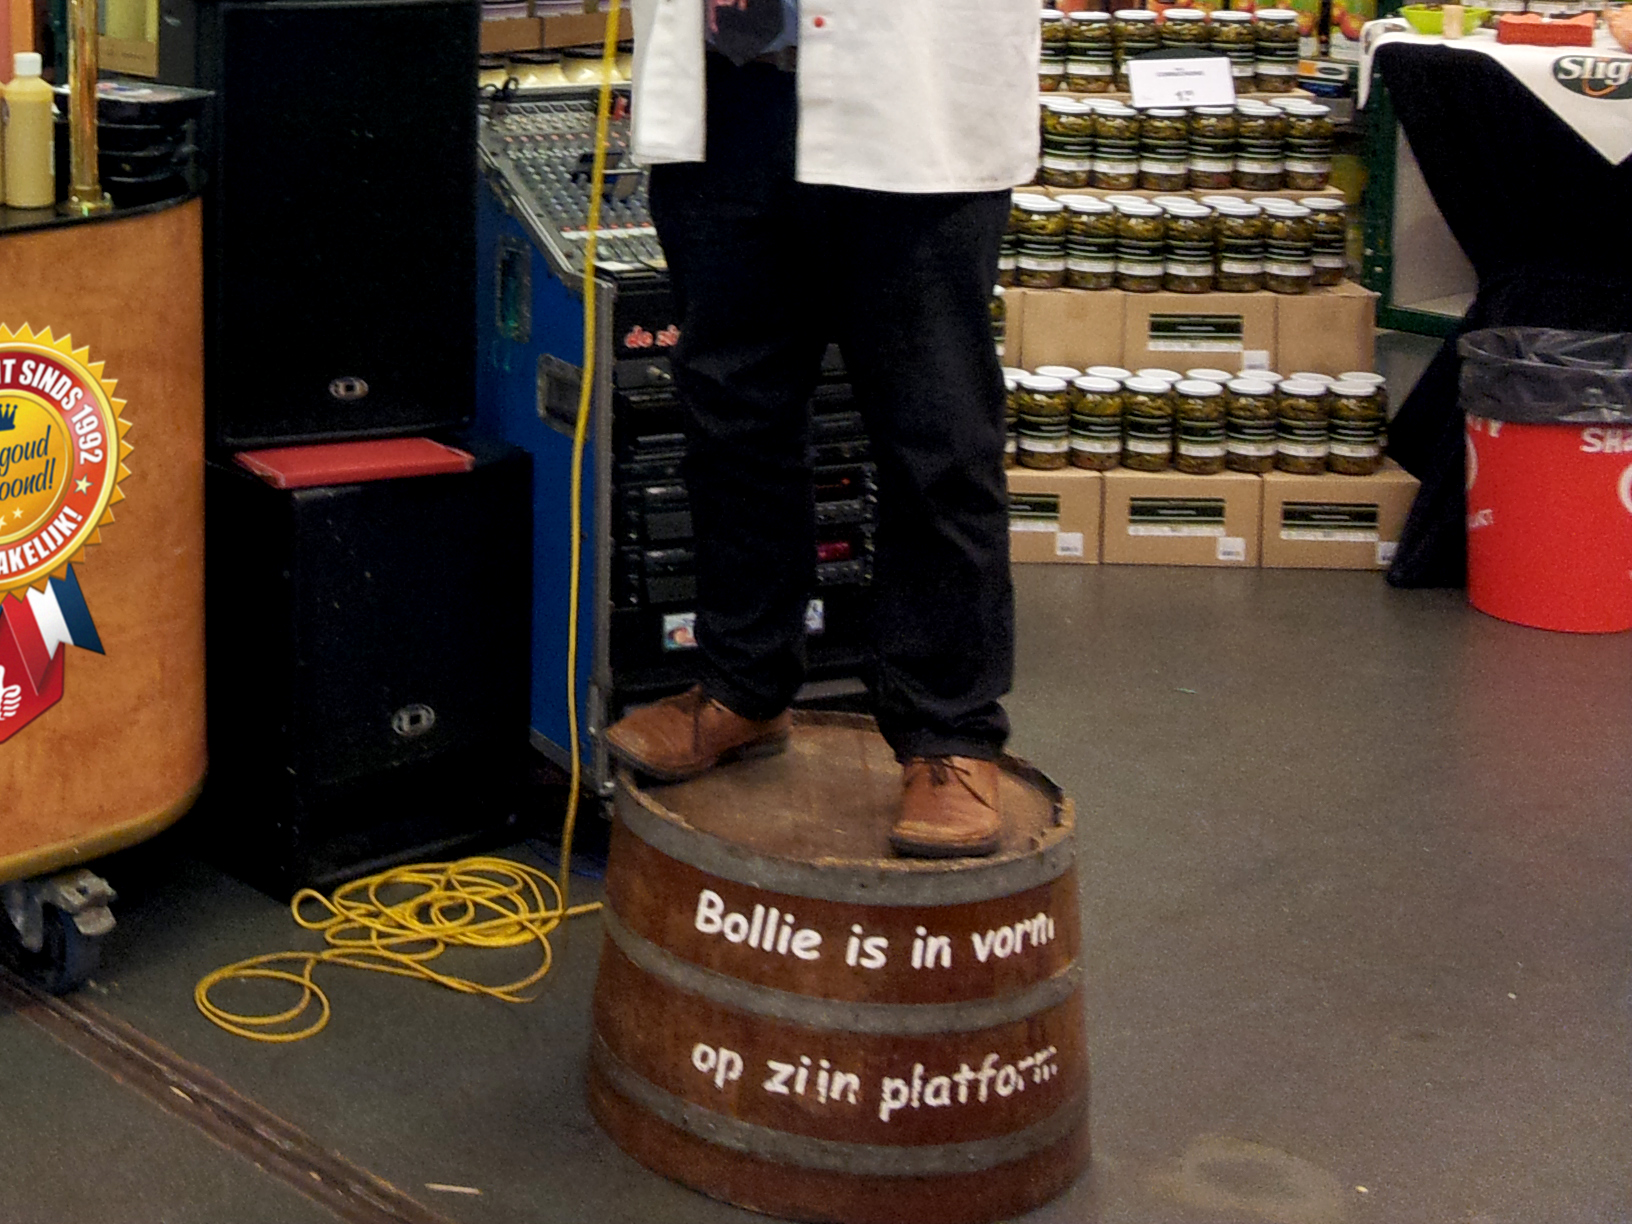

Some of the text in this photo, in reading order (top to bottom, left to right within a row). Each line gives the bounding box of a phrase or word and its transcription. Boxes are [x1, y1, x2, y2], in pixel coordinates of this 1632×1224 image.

[1557, 56, 1632, 86] Slig
[19, 358, 83, 412] SINDS
[71, 403, 104, 466] 1992
[695, 889, 1055, 969] Bollie is in vorm
[691, 1042, 744, 1089] op
